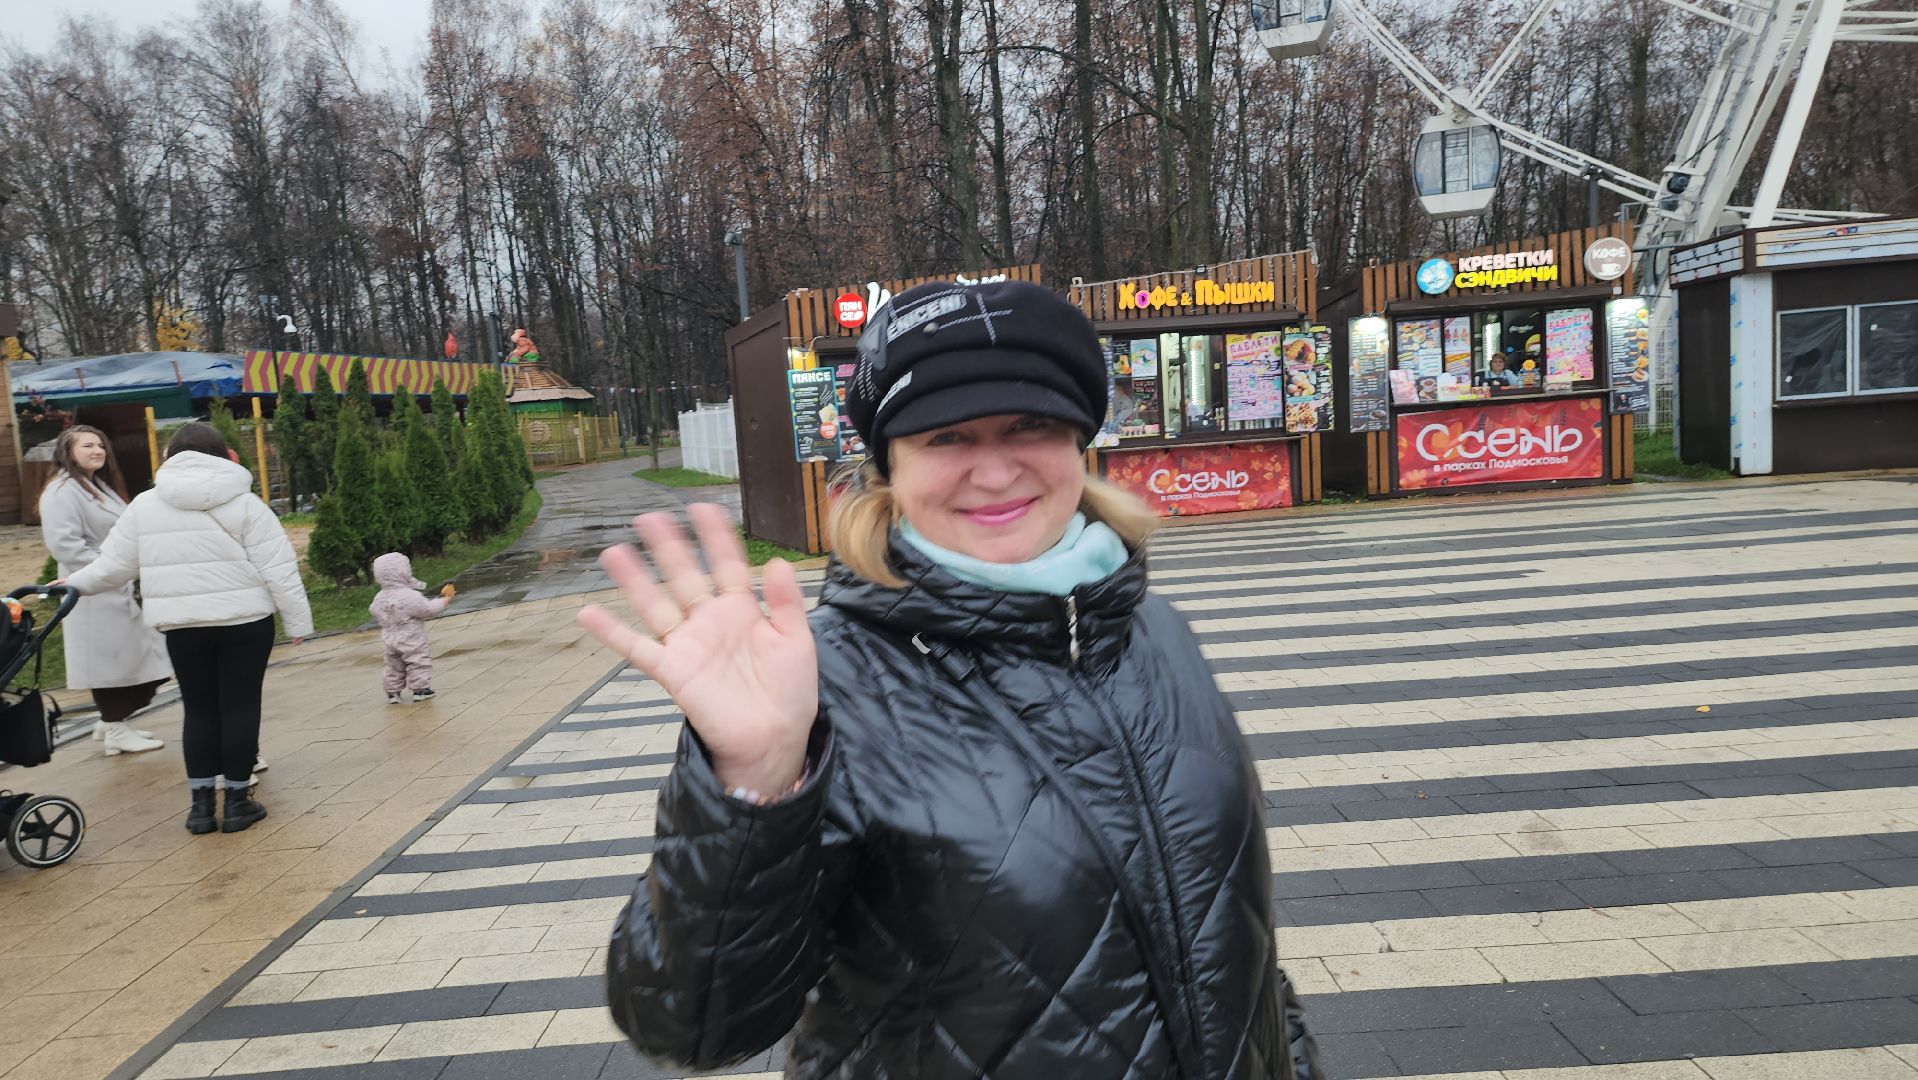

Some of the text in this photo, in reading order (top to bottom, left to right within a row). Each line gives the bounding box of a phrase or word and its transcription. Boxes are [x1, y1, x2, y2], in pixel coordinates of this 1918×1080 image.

[1458, 249, 1554, 272] КРЕВЕТКИ
[1591, 246, 1626, 259] КОФЕ
[1455, 264, 1558, 288] СЭНДВИЧИ
[839, 301, 862, 313] ПЯН
[1180, 291, 1193, 306] &
[792, 371, 832, 384] ПЯНСЕ
[1416, 423, 1583, 462] Осень
[1433, 455, 1569, 473] в парках Подмосковья
[1149, 468, 1249, 494] Осень
